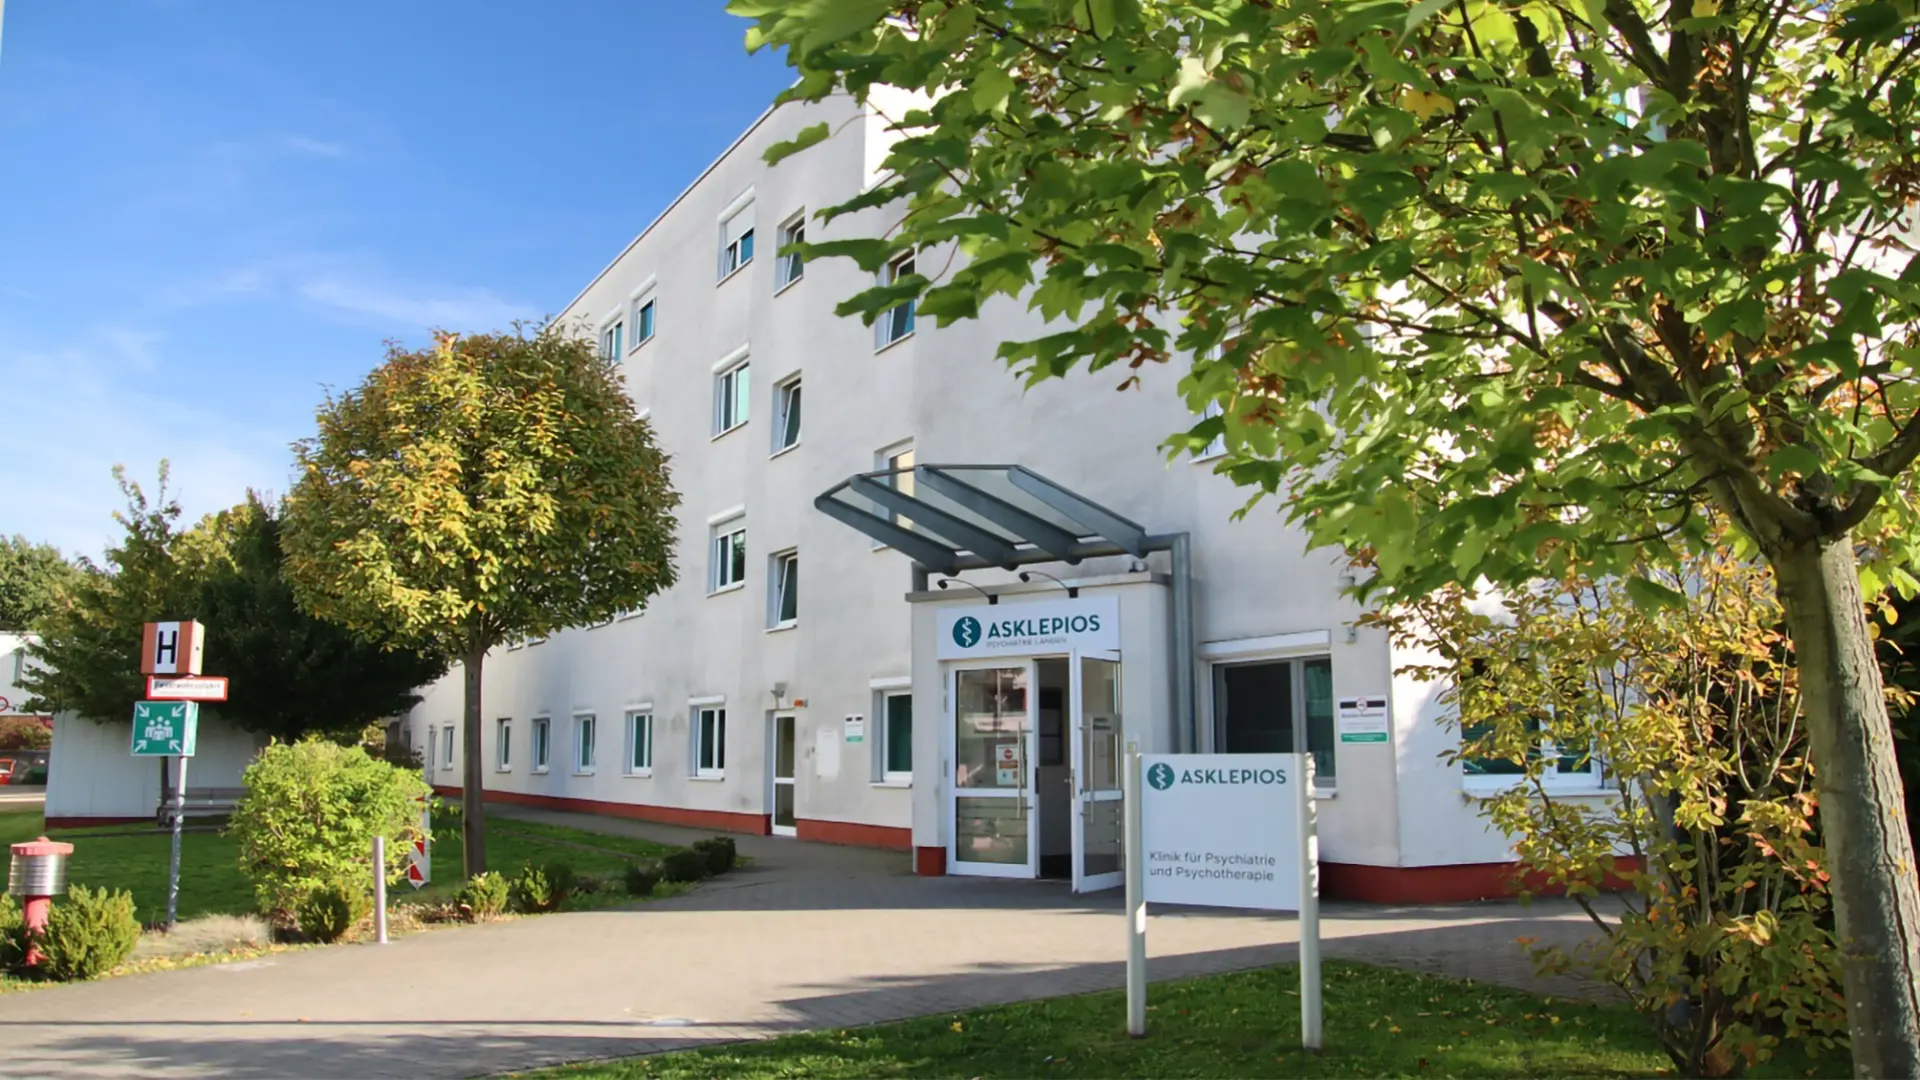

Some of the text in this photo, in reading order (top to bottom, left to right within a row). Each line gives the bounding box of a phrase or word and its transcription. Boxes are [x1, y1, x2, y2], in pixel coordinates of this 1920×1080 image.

[989, 615, 1100, 639] ASKLEPIOS
[156, 631, 177, 664] H
[1180, 769, 1287, 784] ASKLEPIOS
[1150, 851, 1276, 867] Klinik für Psychiatrie
[1150, 867, 1274, 882] und Psychotherapie
